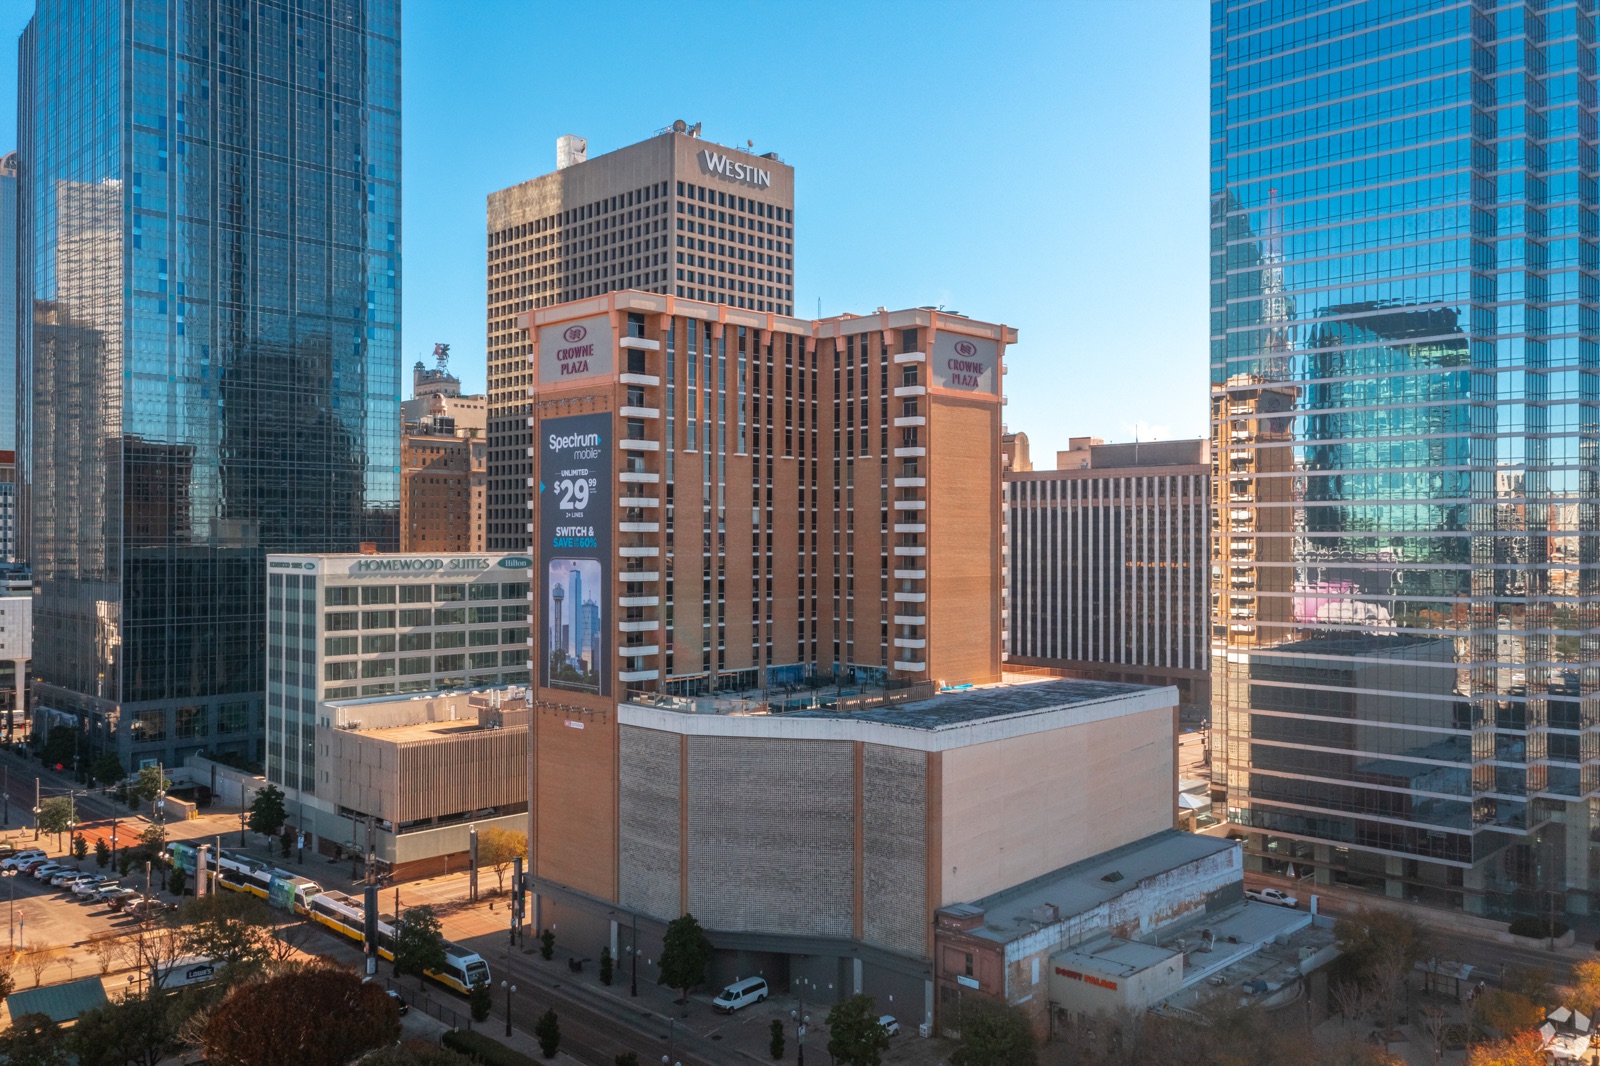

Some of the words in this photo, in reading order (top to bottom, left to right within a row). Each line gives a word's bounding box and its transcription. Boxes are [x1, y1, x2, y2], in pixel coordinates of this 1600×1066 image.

[704, 149, 770, 187] WESTIN
[556, 344, 594, 361] CROWNE
[561, 360, 589, 376] PLAZA
[947, 358, 984, 375] CROWNE
[952, 373, 979, 388] PLAZA
[549, 432, 598, 453] Spectrum
[573, 448, 599, 460] mobile
[560, 468, 589, 477] UNLIMITED
[555, 526, 587, 537] SWITCH
[588, 526, 595, 537] &
[553, 537, 573, 548] SAVE
[579, 537, 598, 548] 60%
[358, 558, 444, 572] HOMEWOOD
[449, 558, 490, 571] SUITES
[505, 558, 527, 568] Hilton
[188, 968, 212, 978] LOWE'S
